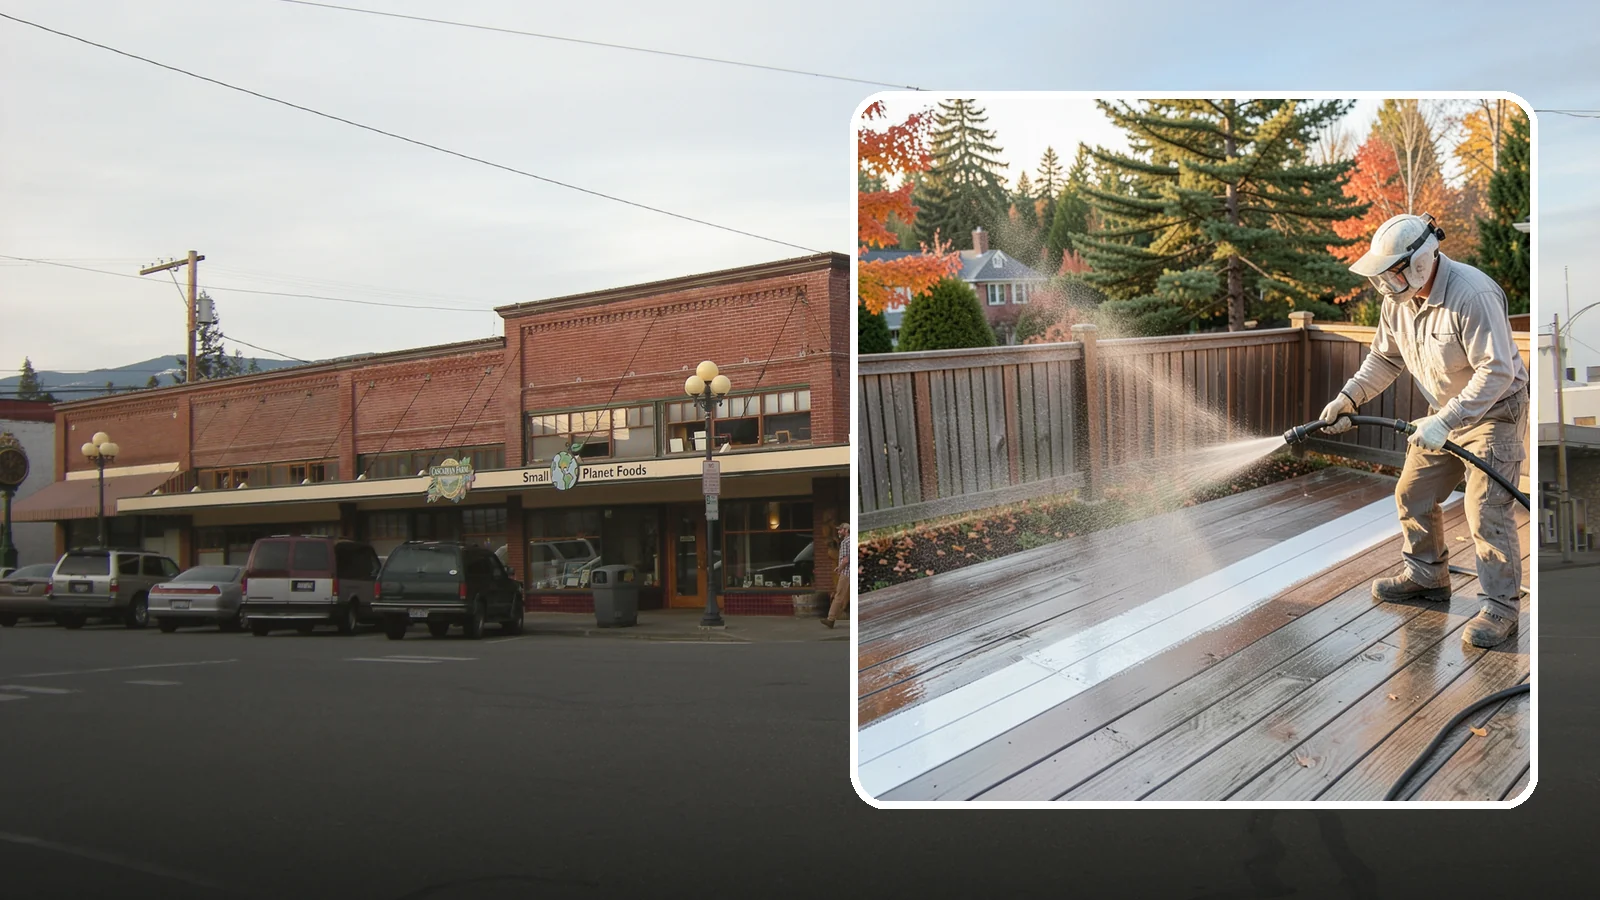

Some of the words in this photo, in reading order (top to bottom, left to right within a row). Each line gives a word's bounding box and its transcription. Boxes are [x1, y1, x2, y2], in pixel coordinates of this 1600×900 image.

[523, 471, 549, 483] Small
[582, 468, 614, 479] Planet
[616, 464, 647, 477] Foods
